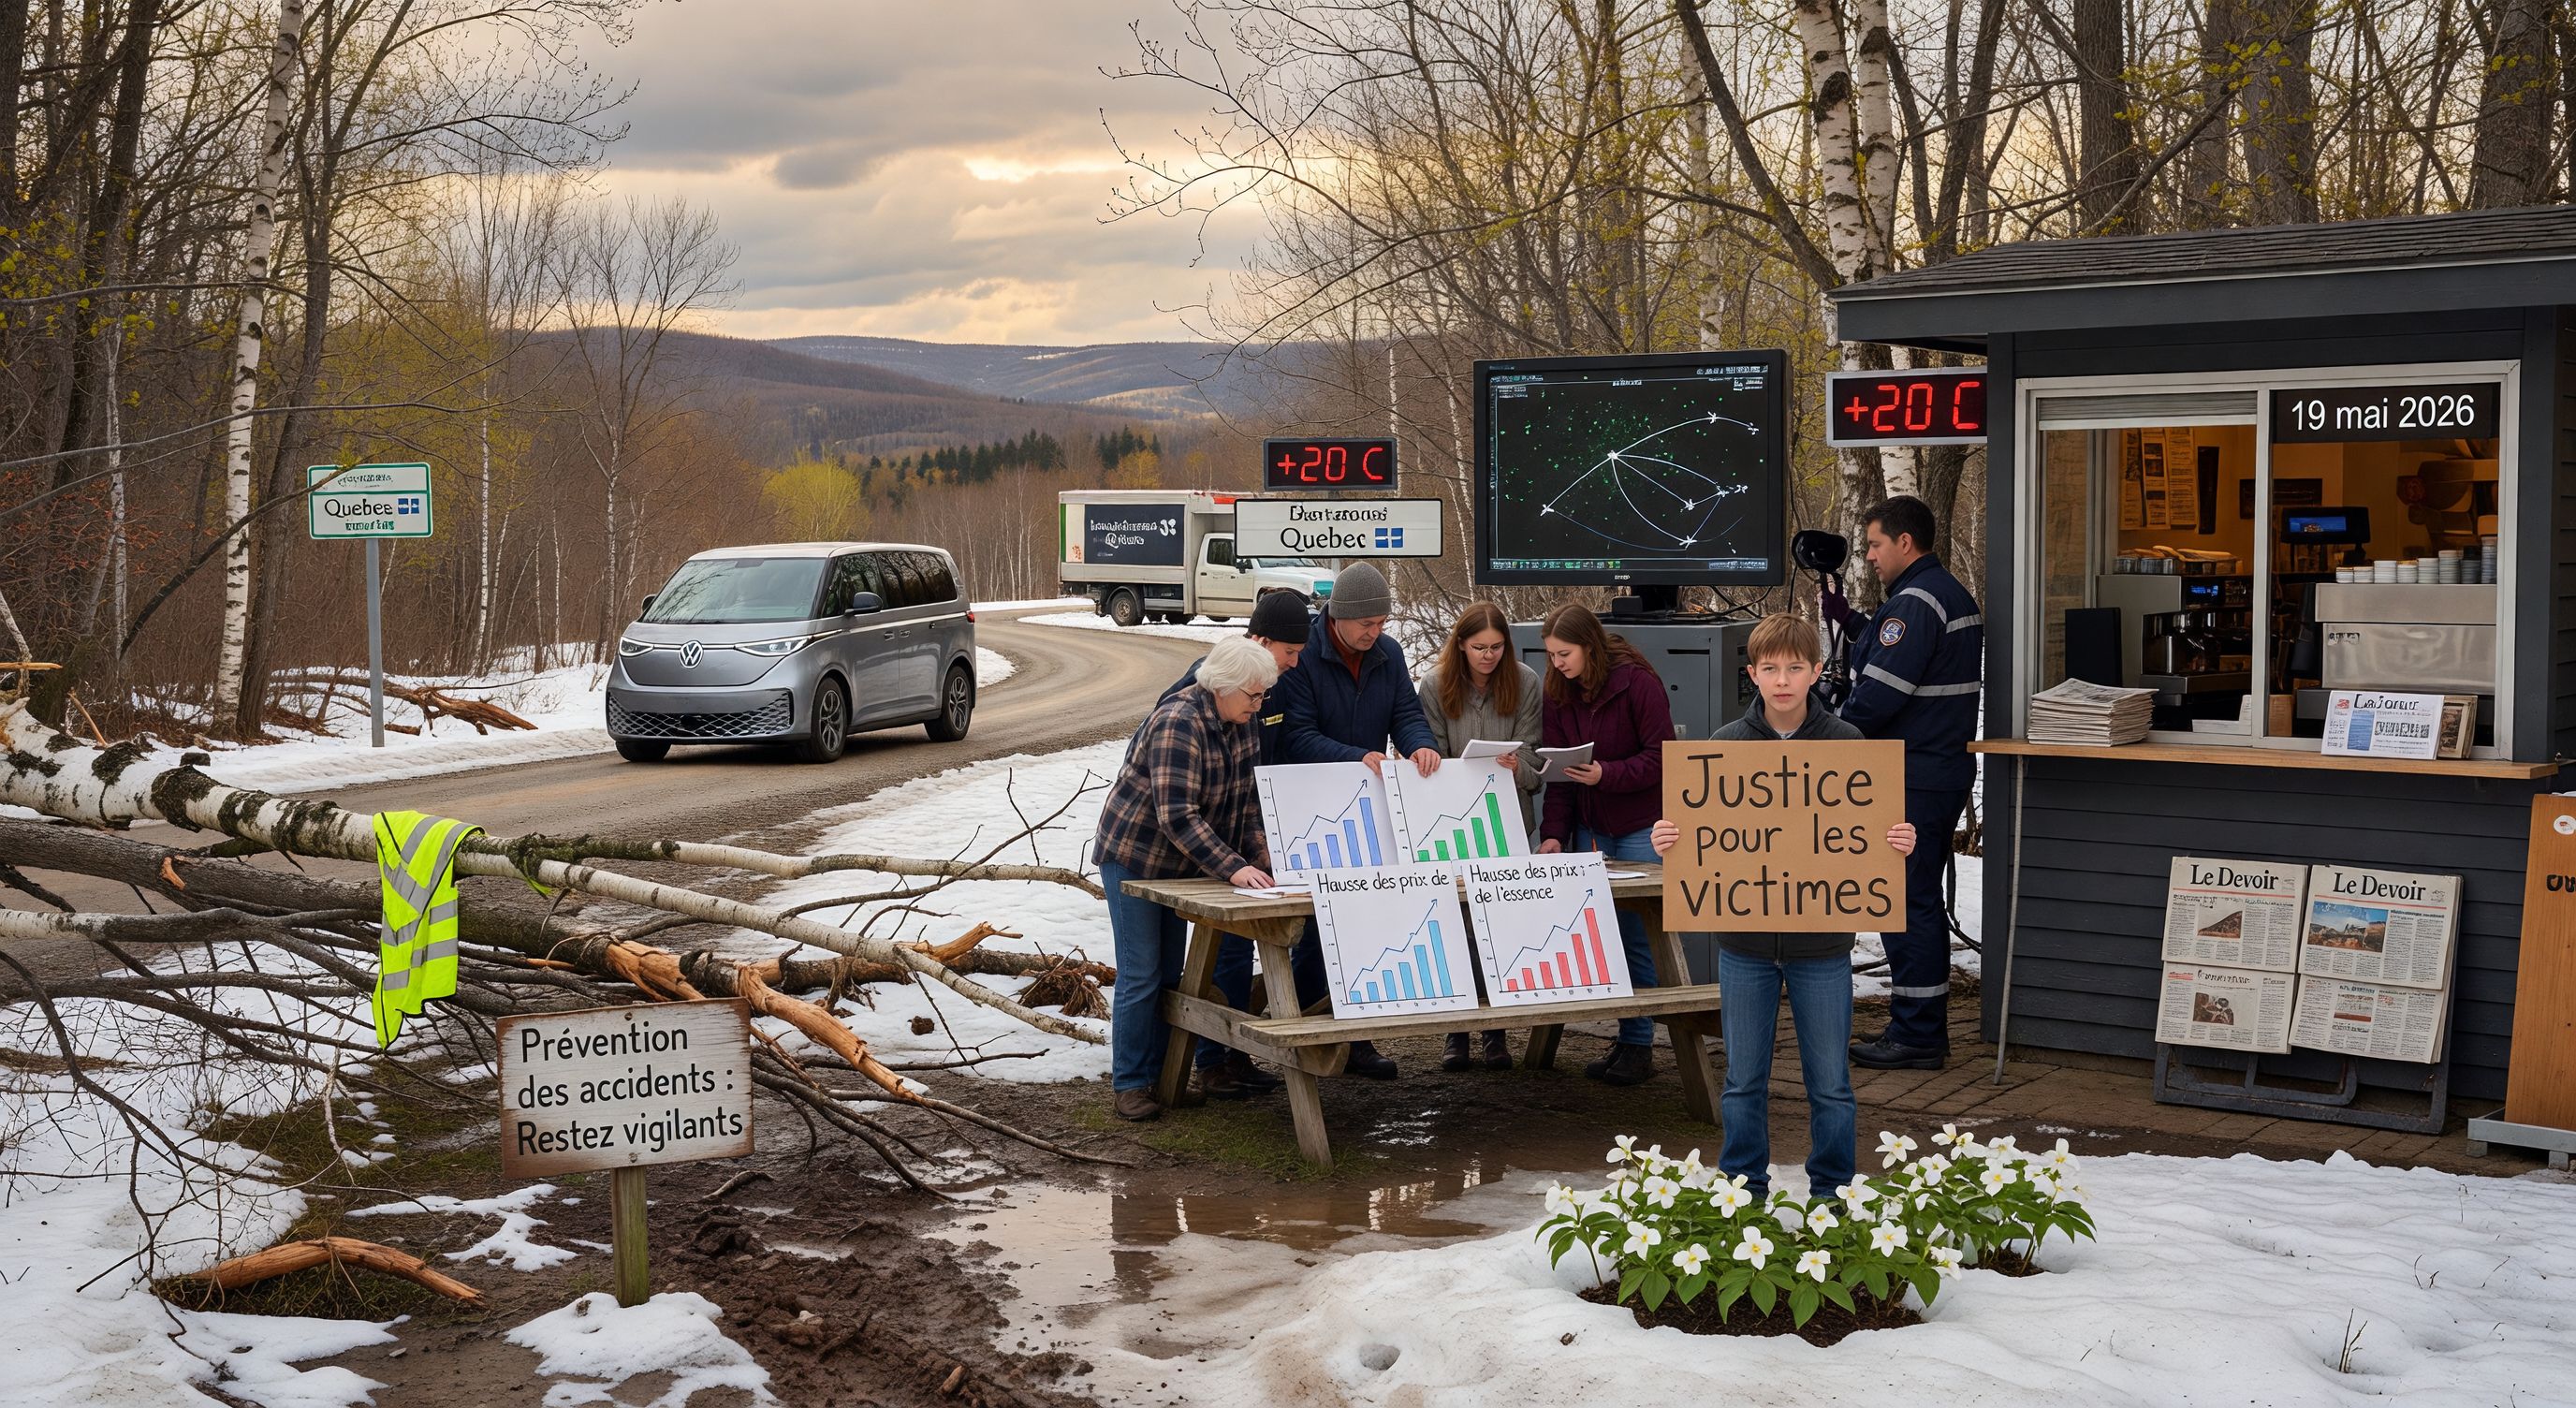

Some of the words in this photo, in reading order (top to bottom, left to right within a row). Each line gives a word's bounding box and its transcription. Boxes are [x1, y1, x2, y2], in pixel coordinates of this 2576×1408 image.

[1844, 383, 1933, 432] +20
[1953, 381, 1980, 430] C
[2291, 399, 2326, 431] 19
[2336, 397, 2388, 429] mai
[2398, 394, 2475, 428] 2026
[1277, 447, 1347, 482] +20
[1362, 447, 1383, 480] C
[1682, 754, 1873, 809] Justice
[1696, 826, 1782, 867] pour
[1813, 813, 1868, 855] les
[1316, 873, 1369, 894] Hausse
[1372, 872, 1397, 890] des
[1399, 873, 1428, 894] prix
[1431, 869, 1450, 886] de
[1470, 863, 1521, 884] Hausse
[1525, 861, 1547, 879] des
[1550, 862, 1578, 882] prix
[1680, 864, 1892, 917] victimes
[2190, 864, 2214, 886] Le
[2217, 866, 2279, 890] Devoir
[2333, 873, 2357, 894] Le
[2360, 875, 2426, 901] Devoir
[1474, 888, 1492, 903] de
[1495, 885, 1554, 902] l'essence
[521, 1021, 688, 1063] Prévention
[518, 1075, 569, 1109] des
[579, 1063, 716, 1104] accidents
[726, 1069, 734, 1091] :
[518, 1121, 614, 1155] Restez
[622, 1107, 743, 1152] vigilants
